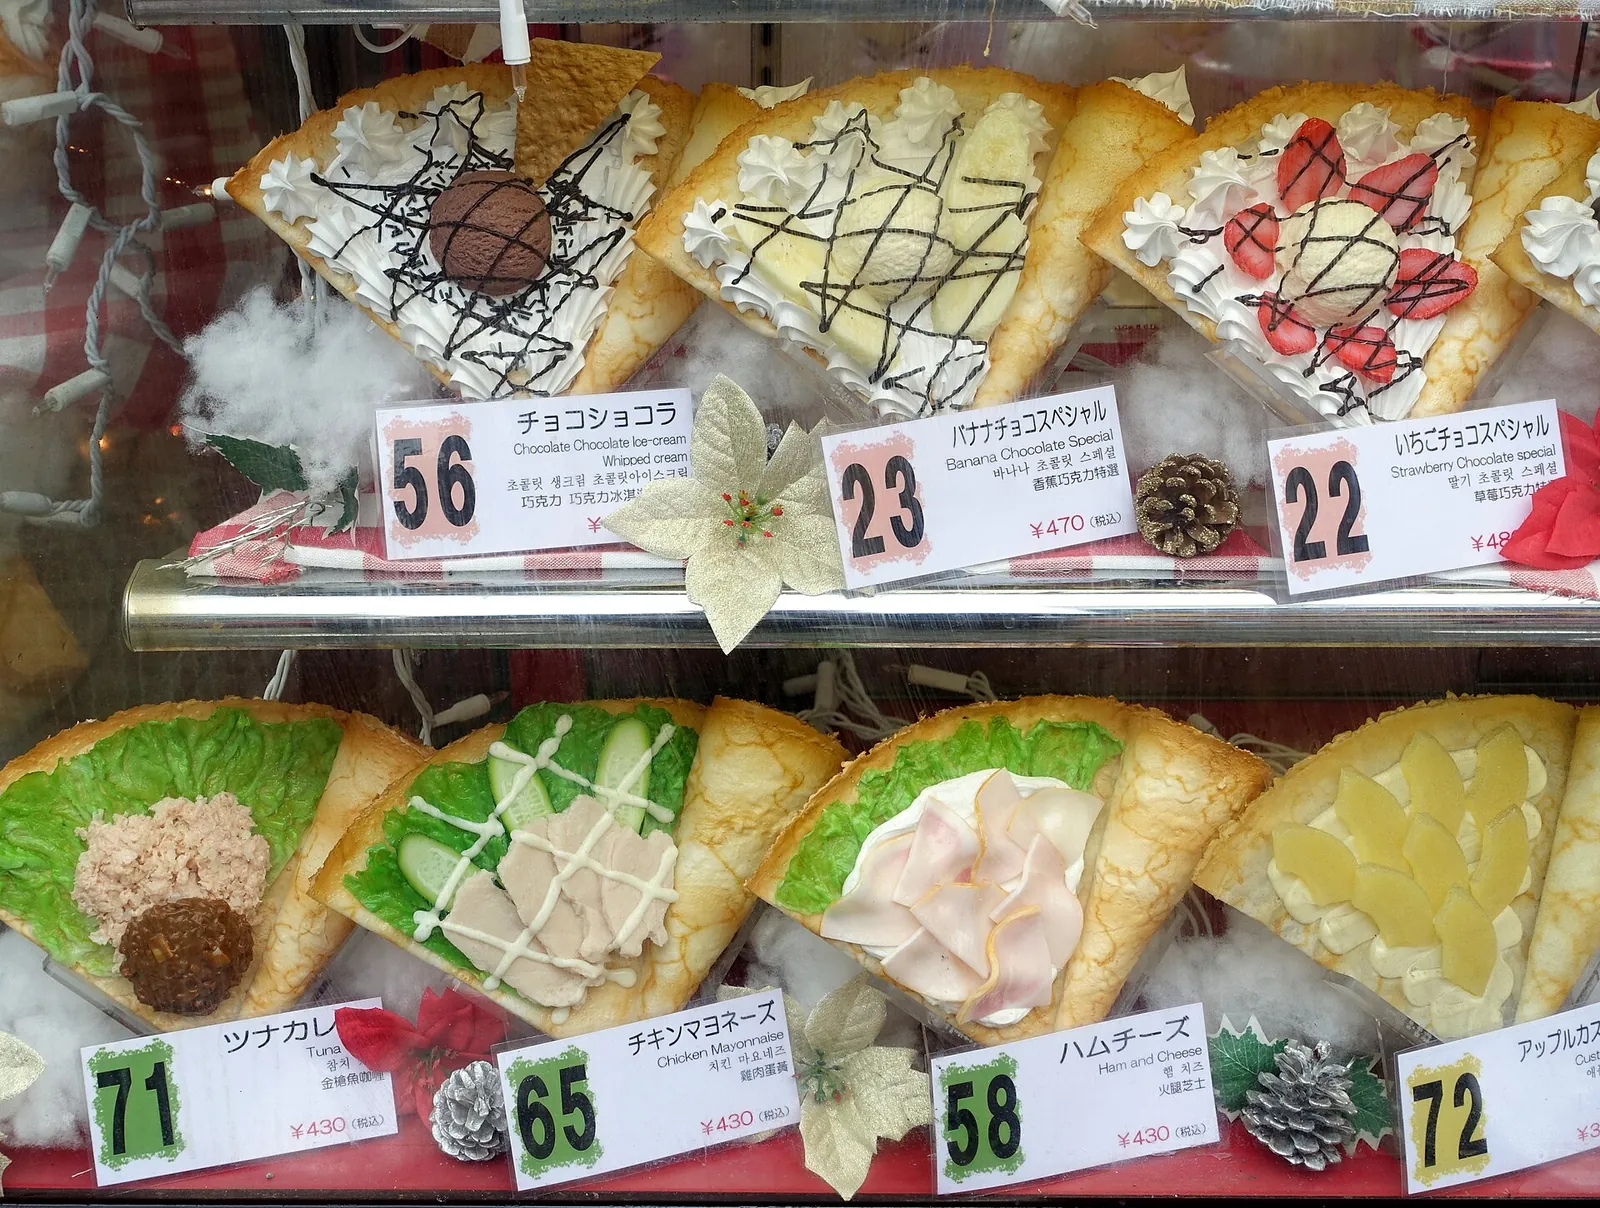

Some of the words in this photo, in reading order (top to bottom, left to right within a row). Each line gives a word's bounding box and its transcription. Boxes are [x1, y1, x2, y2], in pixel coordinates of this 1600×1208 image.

[517, 401, 677, 435] チョコショコラ
[952, 400, 1107, 449] バナナチョコスペシャル
[513, 439, 571, 456] Chocolate
[573, 436, 630, 453] Chocolate
[632, 433, 687, 449] Ice-cream
[946, 453, 998, 472] Banana
[1000, 439, 1066, 461] Chocolate
[1068, 428, 1114, 448] Special
[1395, 414, 1550, 457] いちごチョコスペシャル
[602, 452, 651, 468] Whipped
[653, 452, 688, 465] cream
[993, 461, 1030, 480] 바나나
[1037, 453, 1073, 472] 초콜릿
[1080, 445, 1117, 463] 스페셜
[1390, 460, 1454, 480] Strawberry
[1456, 451, 1514, 470] Chocolate
[1517, 443, 1557, 461] special
[1448, 473, 1472, 490] 딸기
[1478, 467, 1515, 485] 초콜릿
[1521, 461, 1558, 478] 스페셜
[393, 434, 476, 531] 56
[507, 477, 543, 492] 초콜릿
[550, 474, 586, 490] 생크림
[1033, 463, 1120, 492] 香蕉巧克力特選
[1474, 480, 1553, 503] 草莓巧克力
[521, 494, 562, 509] 巧克力
[569, 488, 643, 506] 巧克力冰淇
[842, 455, 925, 559] 23
[1285, 460, 1370, 563] 22
[1029, 513, 1085, 539] ¥470
[224, 1016, 336, 1054] ツナカレ
[628, 999, 776, 1056] チキンマヨネーズ
[1060, 1015, 1190, 1064] ハムチーズ
[306, 1045, 342, 1058] Tuna
[326, 1057, 350, 1073] 참치
[657, 1048, 709, 1069] Chicken
[711, 1031, 785, 1056] Mayonnaise
[708, 1056, 732, 1073] 치킨
[738, 1045, 786, 1065] 마요네즈
[1098, 1062, 1127, 1075] Ham
[1130, 1053, 1153, 1069] and
[1157, 1046, 1203, 1063] Cheese
[1181, 1061, 1204, 1075] 치즈
[1158, 1077, 1206, 1097] 火腿芝士
[96, 1061, 175, 1156] 71
[516, 1063, 597, 1160] 65
[701, 1109, 754, 1136] ¥430
[946, 1073, 1022, 1167] 58
[1412, 1072, 1489, 1168] 72
[290, 1116, 346, 1140] ¥430
[1117, 1125, 1170, 1149] ¥430
